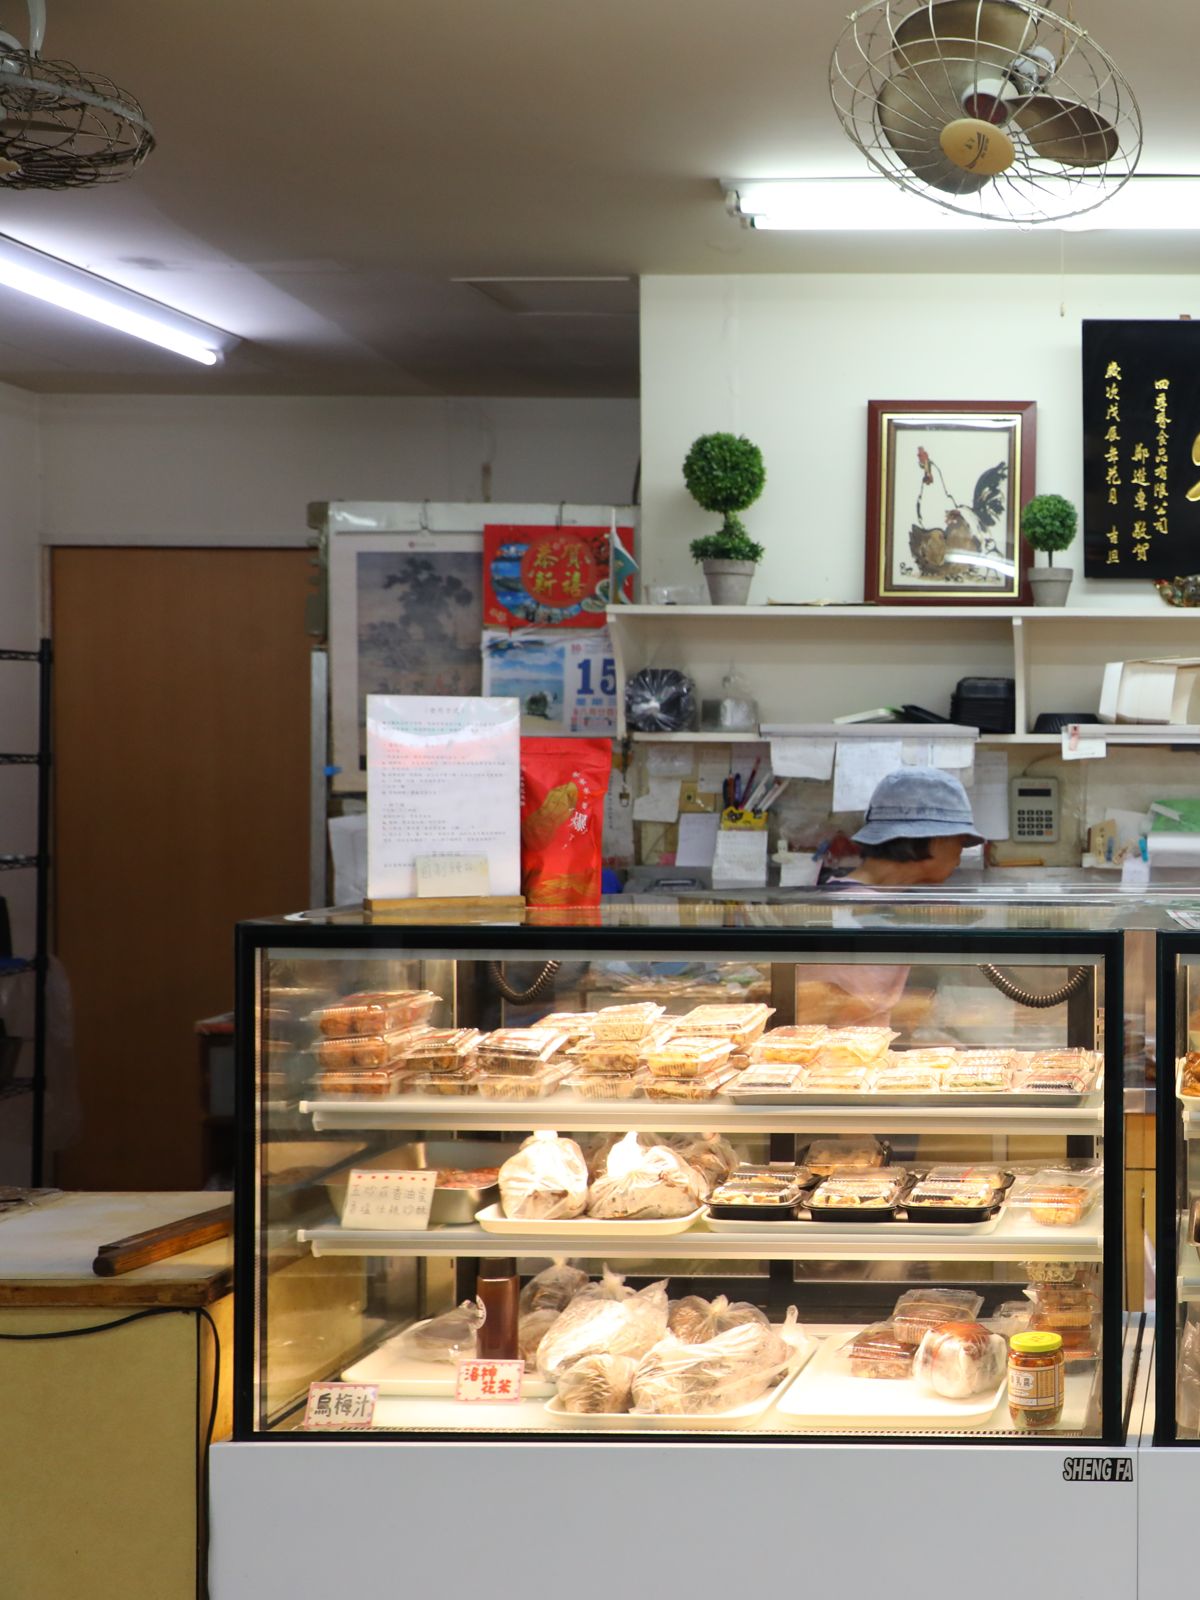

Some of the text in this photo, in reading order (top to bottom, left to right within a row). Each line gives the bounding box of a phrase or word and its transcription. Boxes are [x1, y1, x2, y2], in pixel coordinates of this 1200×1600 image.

[576, 658, 616, 696] 15
[314, 1393, 369, 1418] 烏梅汁
[1063, 1457, 1133, 1481] SHENG FA
